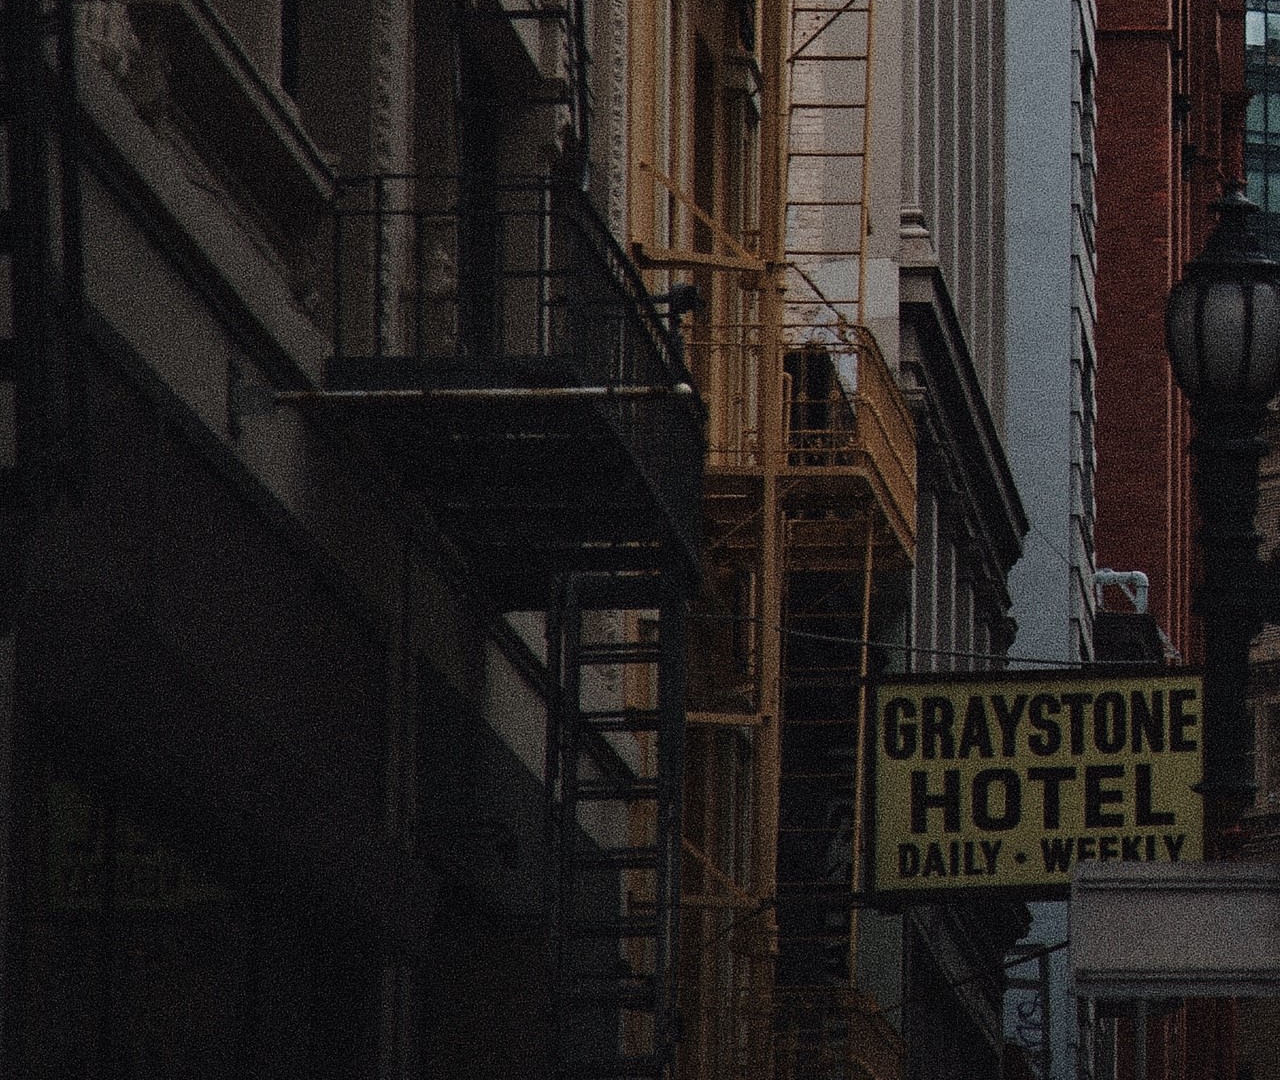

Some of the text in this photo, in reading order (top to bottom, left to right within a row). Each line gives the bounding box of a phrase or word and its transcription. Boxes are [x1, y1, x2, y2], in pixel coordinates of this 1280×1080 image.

[884, 689, 1198, 760] GRAYSTONE
[911, 764, 1175, 833] HOTEL
[898, 840, 1002, 878] DAILY
